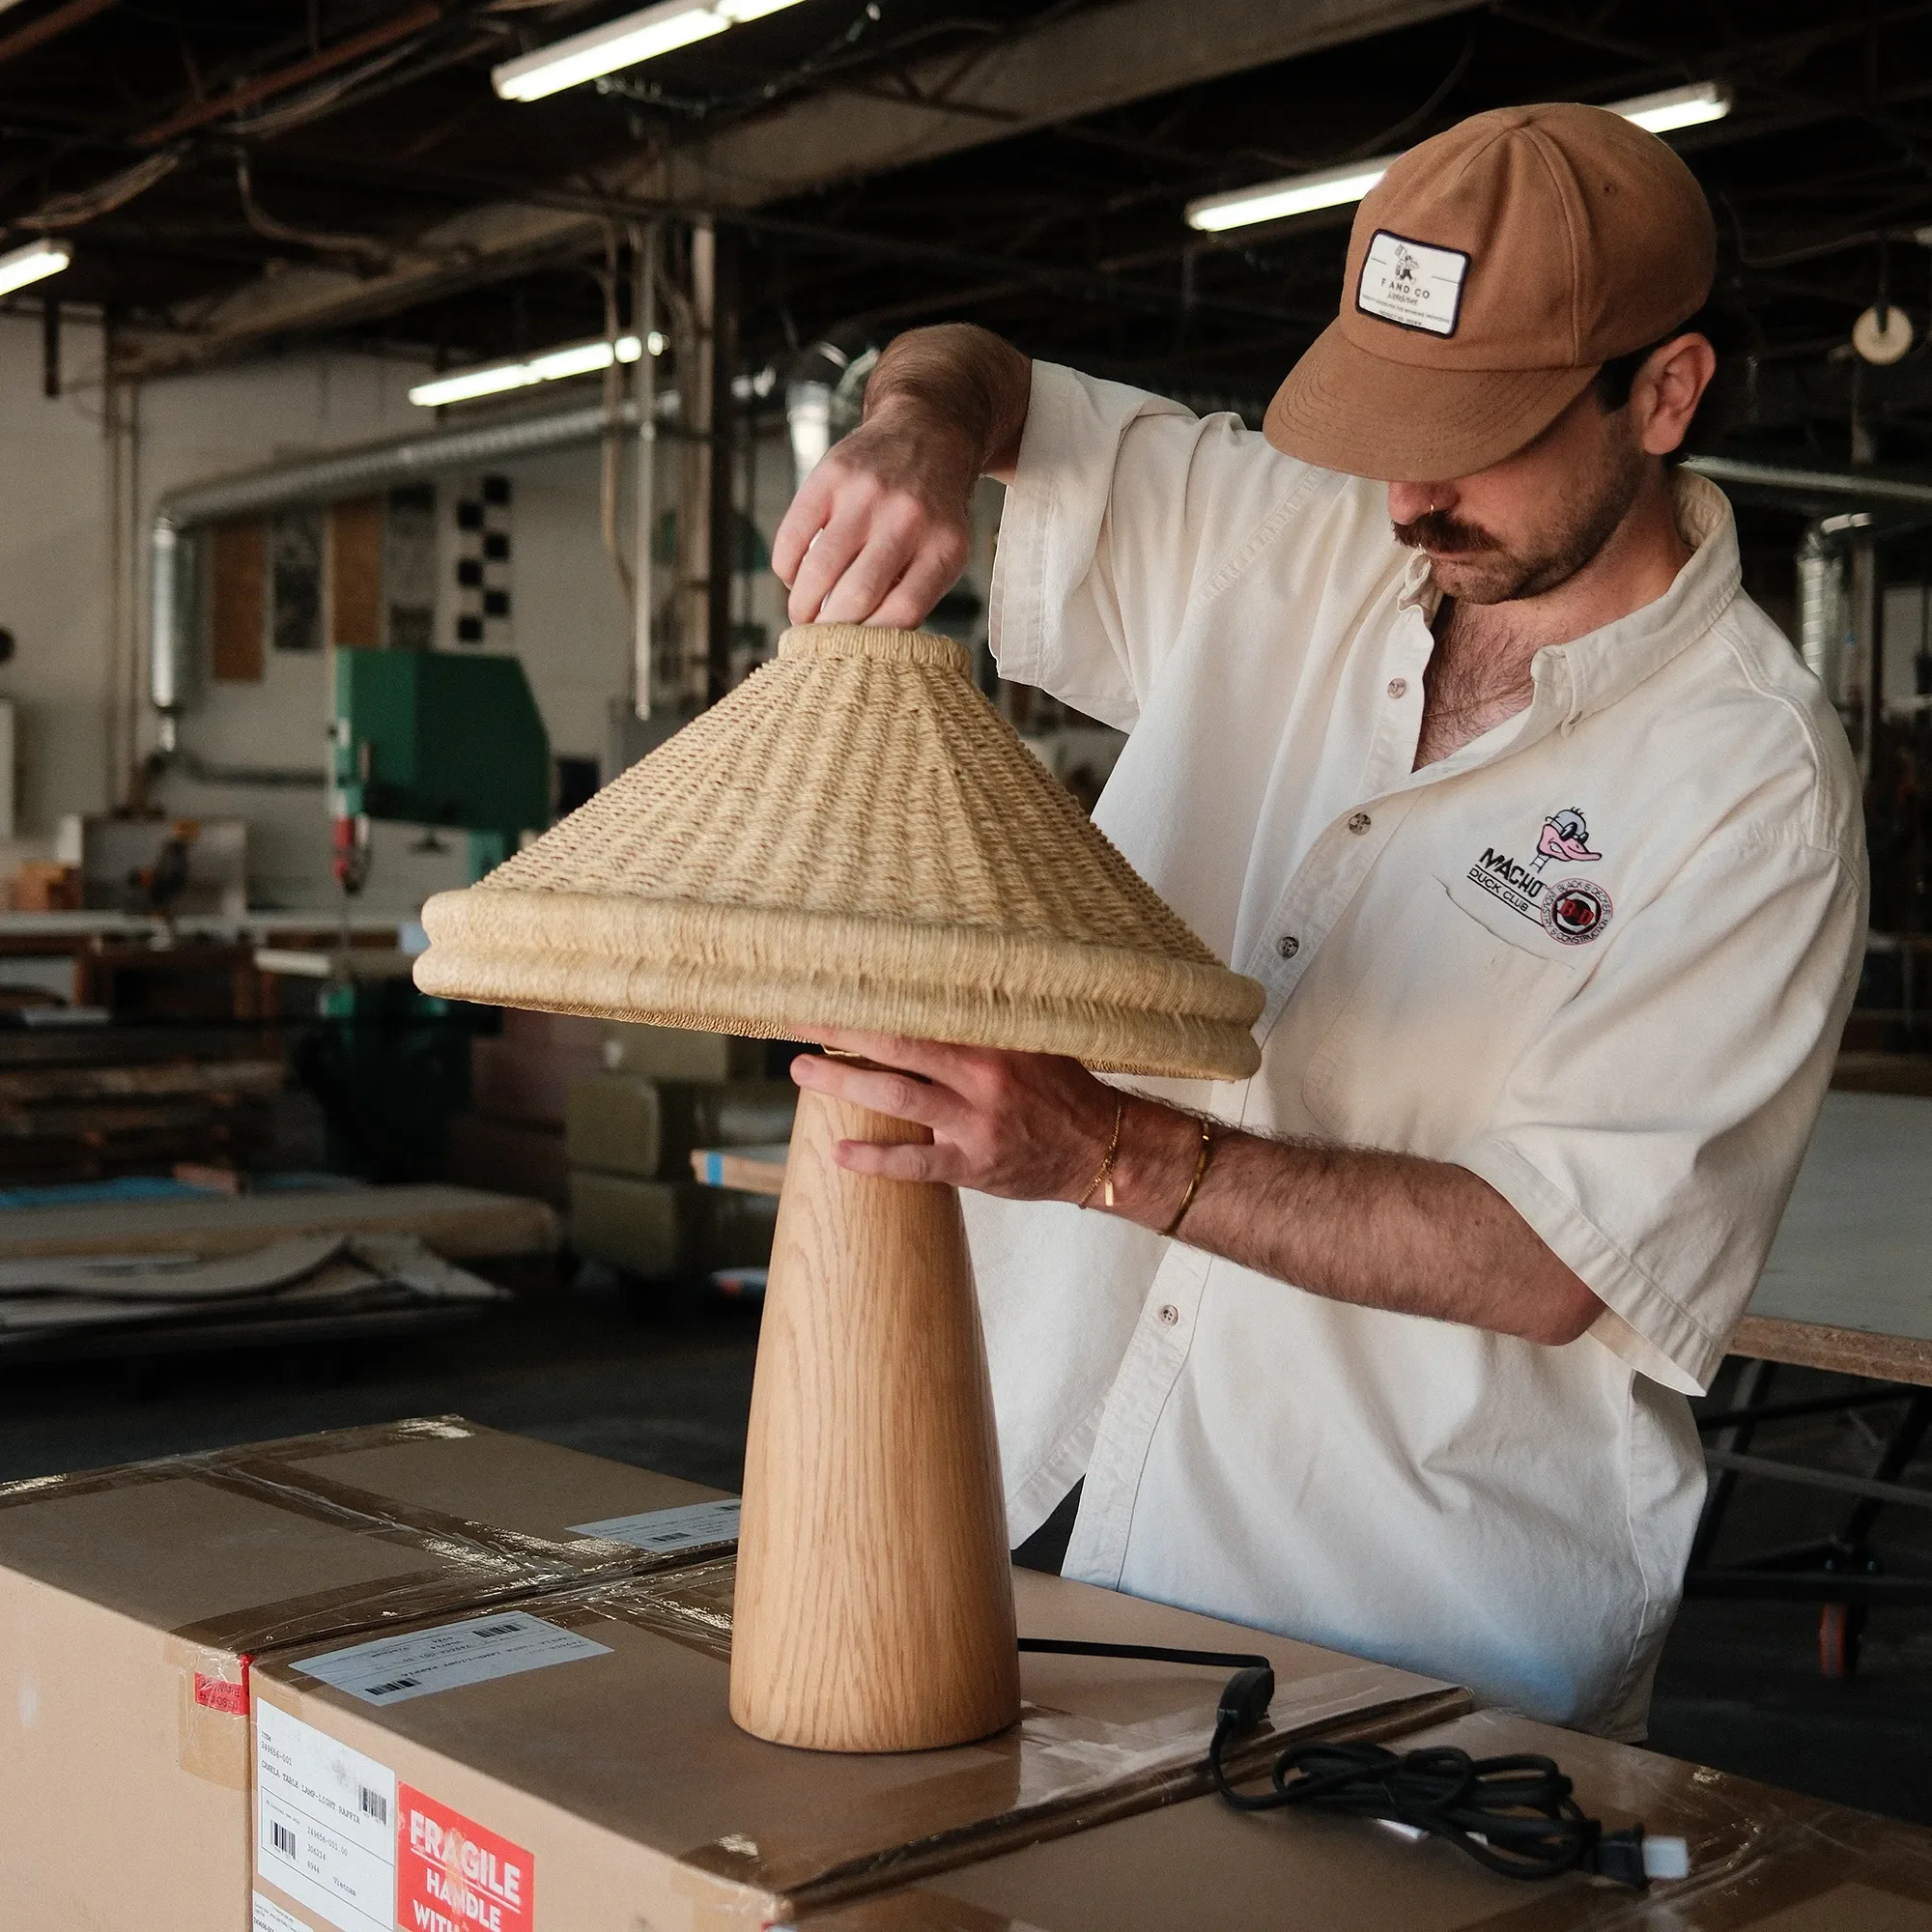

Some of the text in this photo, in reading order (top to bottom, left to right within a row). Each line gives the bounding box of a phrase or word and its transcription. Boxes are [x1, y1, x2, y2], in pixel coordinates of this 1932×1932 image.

[1389, 281, 1410, 294] AND
[1414, 288, 1430, 298] CO
[1468, 867, 1529, 912] DUCK CLUB
[1479, 847, 1544, 898] MACHO
[1557, 880, 1582, 892] BLACK
[1591, 887, 1611, 915] DECKER
[1557, 919, 1608, 944] CONSTRUCTION
[282, 1774, 299, 1789] TABLE
[301, 1784, 336, 1811] LAMP-LIGHT
[411, 1808, 521, 1906] FRAGILE
[333, 1876, 356, 1896] Vietnam
[426, 1867, 501, 1932] HANDLE
